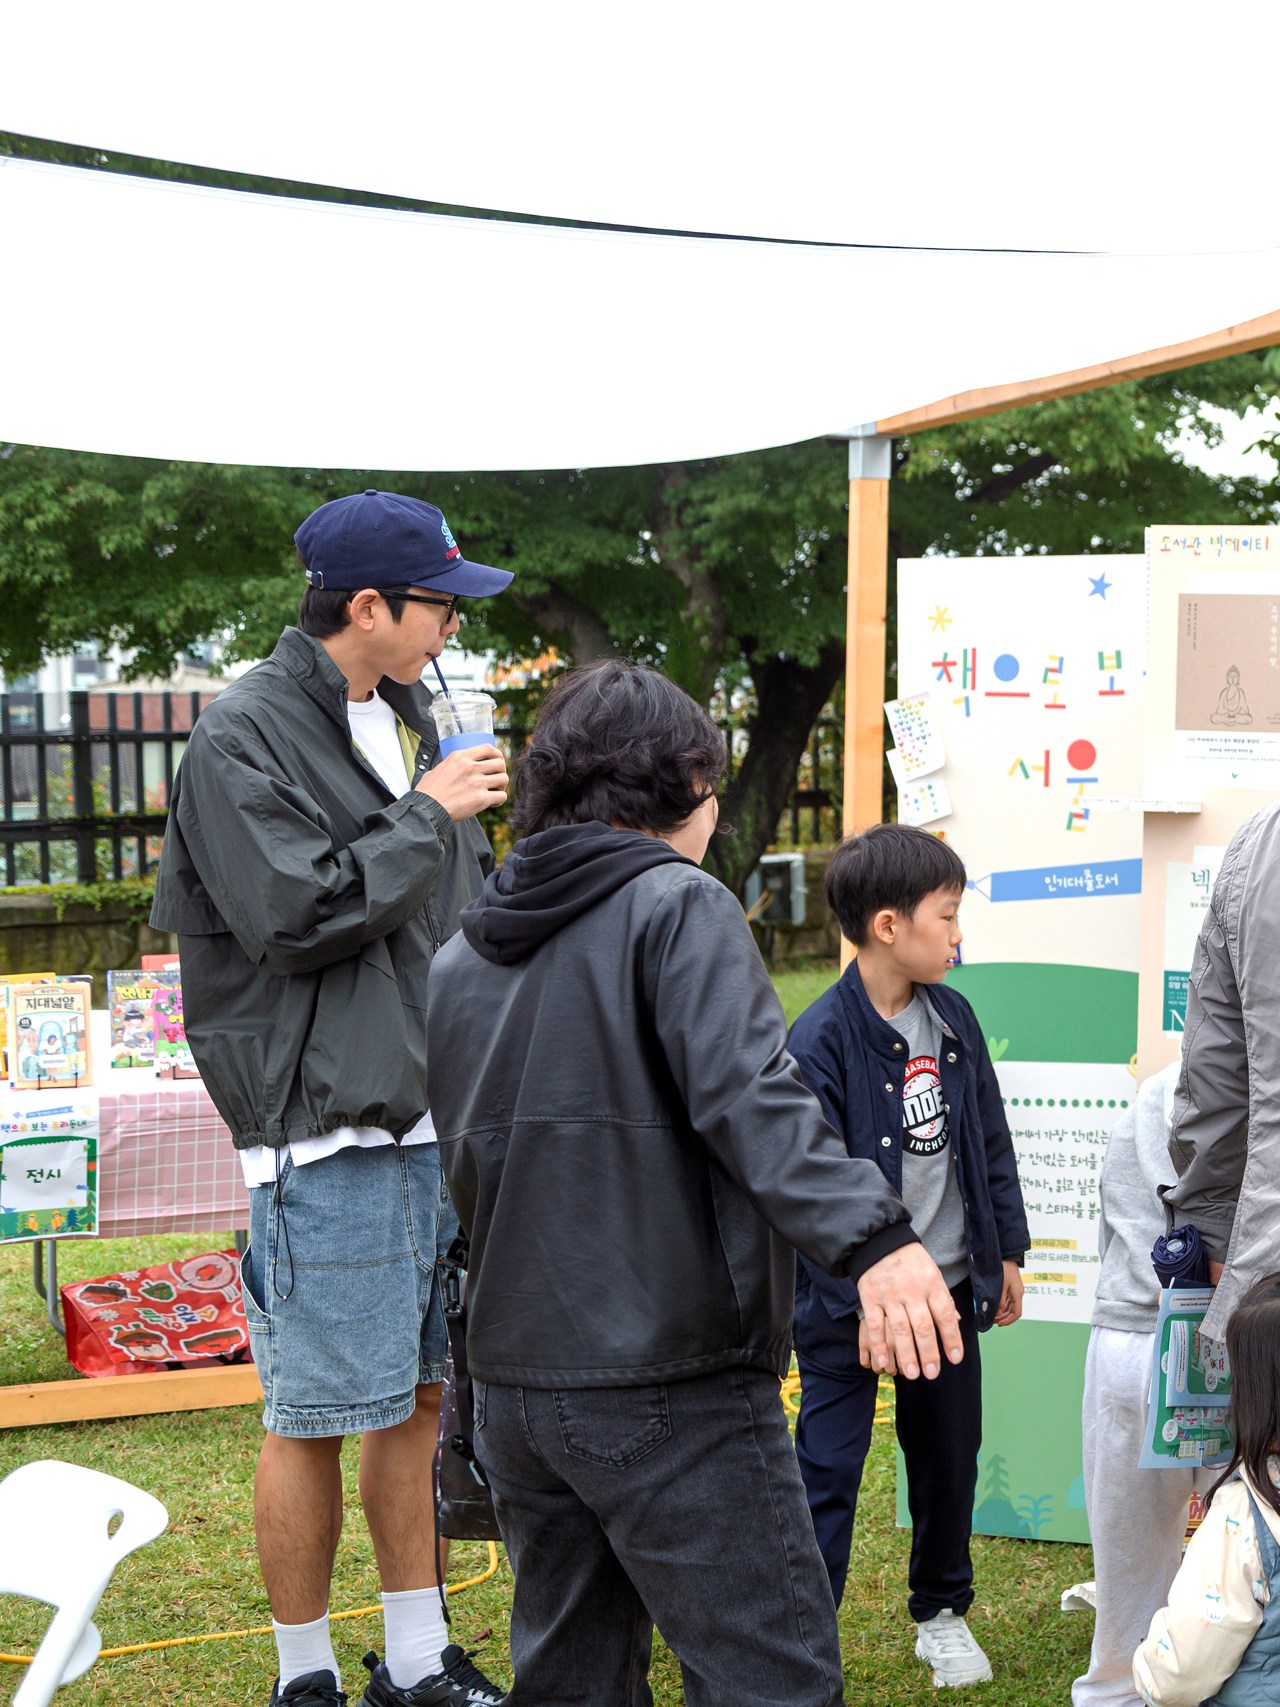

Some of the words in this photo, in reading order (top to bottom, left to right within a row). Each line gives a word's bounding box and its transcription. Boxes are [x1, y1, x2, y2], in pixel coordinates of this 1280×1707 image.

[1160, 536, 1202, 556] 도서관
[1211, 535, 1269, 557] 빅데이터
[932, 648, 1066, 717] 책으로
[1008, 739, 1099, 832] 서울
[1044, 869, 1119, 892] 인기대출도서
[25, 996, 75, 1012] 지대넓얕
[909, 1125, 949, 1151] INCHEON
[1044, 1130, 1068, 1143] 가장
[1072, 1130, 1108, 1144] 인기있는
[1029, 1152, 1066, 1167] 인기있는
[1070, 1153, 1097, 1170] 도서를
[26, 1168, 61, 1188] 전시
[1056, 1178, 1074, 1193] 읽고
[1078, 1178, 1096, 1196] 싶은
[1045, 1201, 1084, 1219] 스티커를
